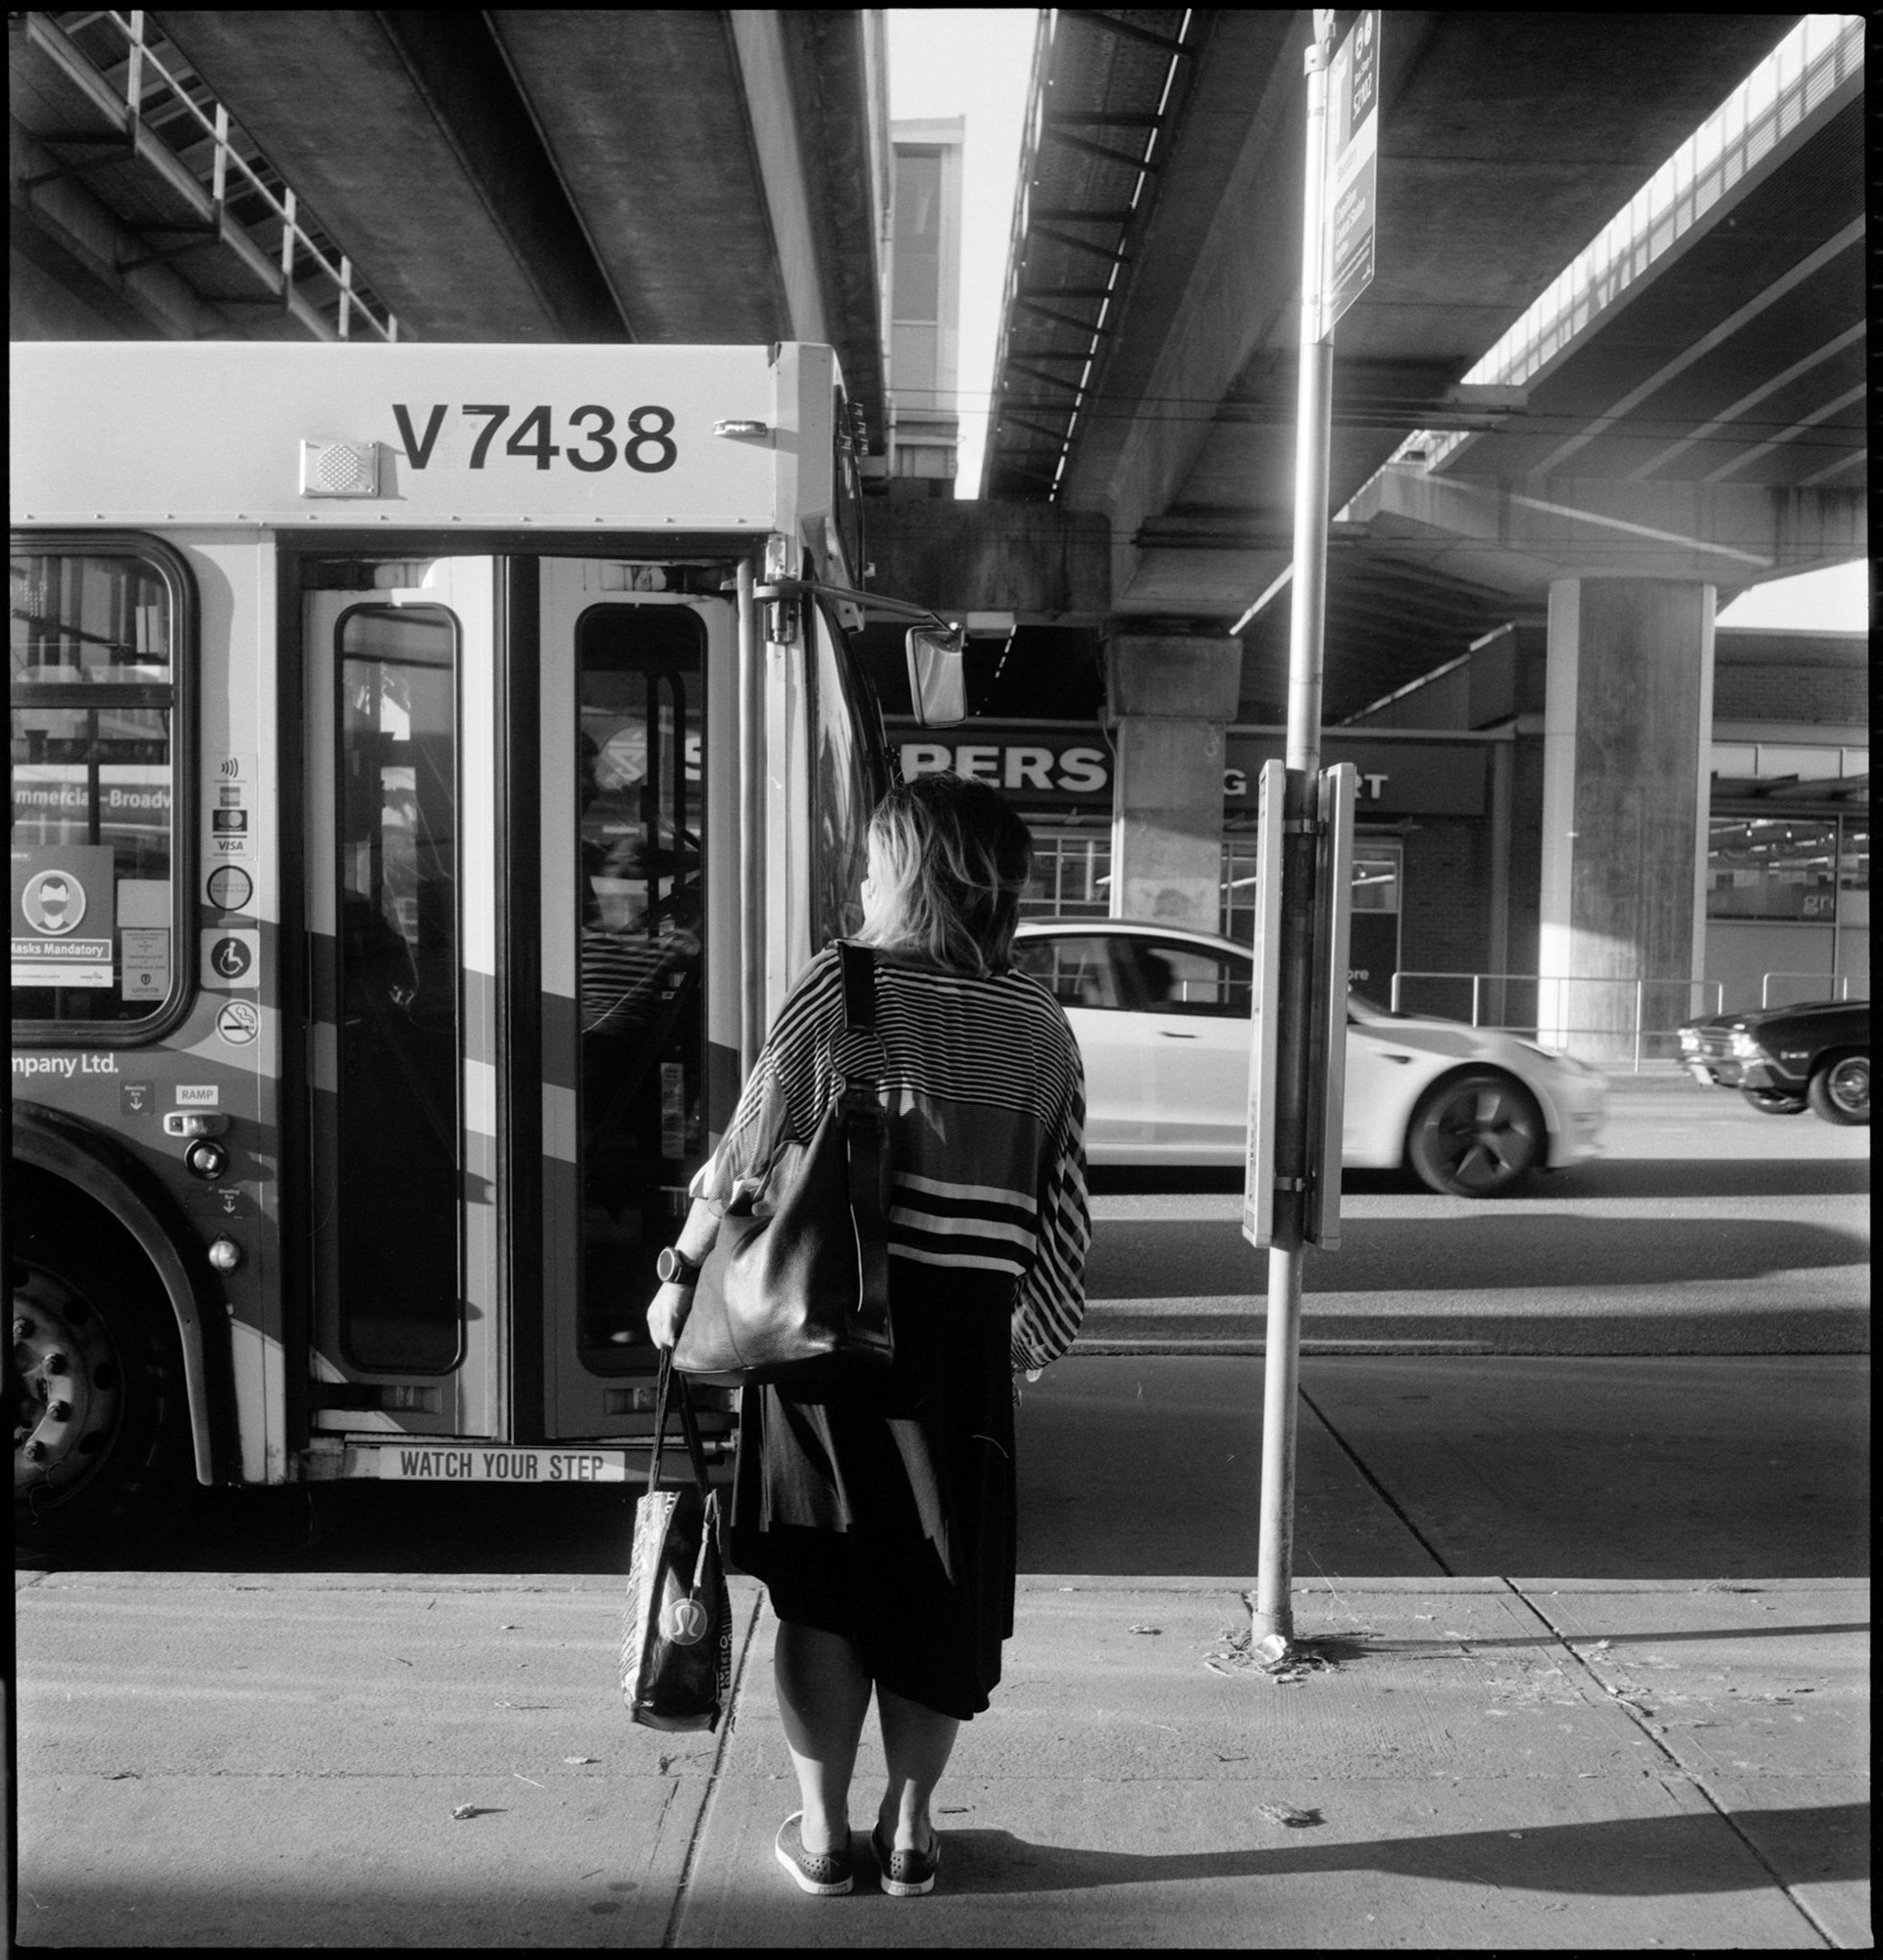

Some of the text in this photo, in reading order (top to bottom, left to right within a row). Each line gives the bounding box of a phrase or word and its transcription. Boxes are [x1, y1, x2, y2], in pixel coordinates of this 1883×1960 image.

[900, 743, 1108, 793] PERS
[218, 840, 243, 851] VISA
[44, 942, 104, 958] Mandatory
[12, 1052, 119, 1079] mpany Ltd.
[181, 1089, 214, 1100] RAMP
[400, 1450, 604, 1482] WATCH YOUR STEP
